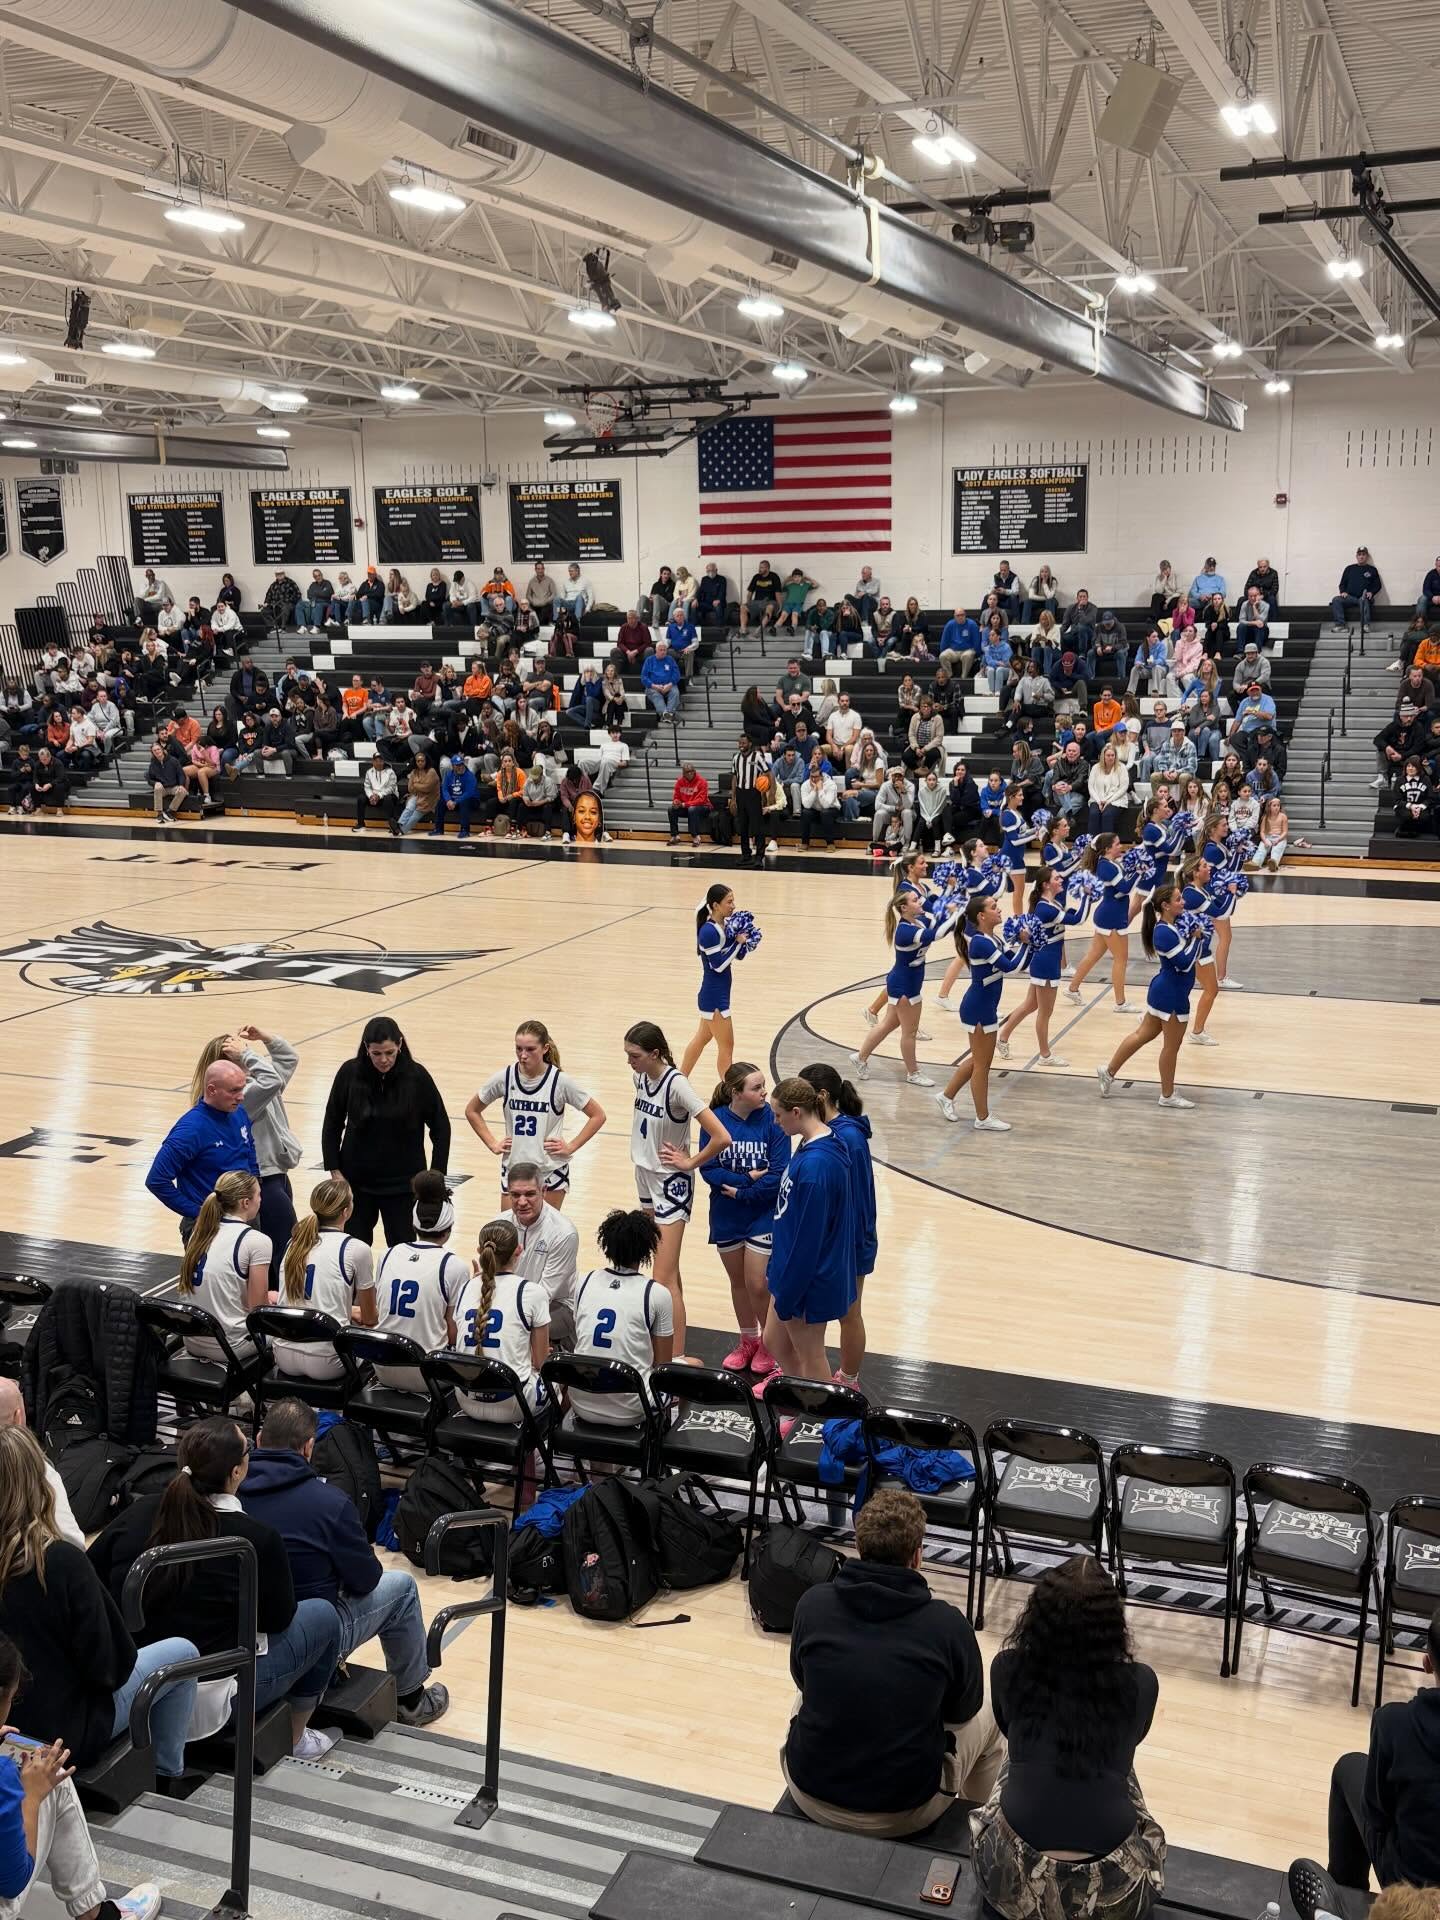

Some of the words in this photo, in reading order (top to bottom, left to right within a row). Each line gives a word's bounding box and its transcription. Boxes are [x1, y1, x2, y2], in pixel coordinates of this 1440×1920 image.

[957, 470, 984, 481] LADY
[988, 469, 1026, 480] EAGLES
[1030, 467, 1083, 479] SOFTBALL
[521, 484, 570, 495] EAGLES
[575, 483, 608, 494] GOLF
[1013, 478, 1035, 486] STATE
[130, 496, 148, 505] LADY
[150, 495, 175, 505] EAGLES
[176, 493, 220, 504] BASKETBALL
[261, 491, 305, 502] EAGLES
[309, 490, 340, 500] GOLF
[385, 488, 432, 498] EAGLES
[437, 487, 468, 497] GOLF
[1407, 791, 1420, 802] 57
[509, 1098, 549, 1113] CATHOLIC
[635, 1097, 664, 1118] ATHOLIC
[515, 1115, 537, 1136] 23
[640, 1117, 647, 1139] 4
[721, 1141, 768, 1155] ATHOLIC
[389, 1278, 419, 1318] 12
[464, 1308, 503, 1348] 32
[592, 1308, 616, 1348] 2
[1018, 1472, 1088, 1489] EHT
[1138, 1493, 1210, 1509] EHT
[1276, 1516, 1356, 1539] EHT
